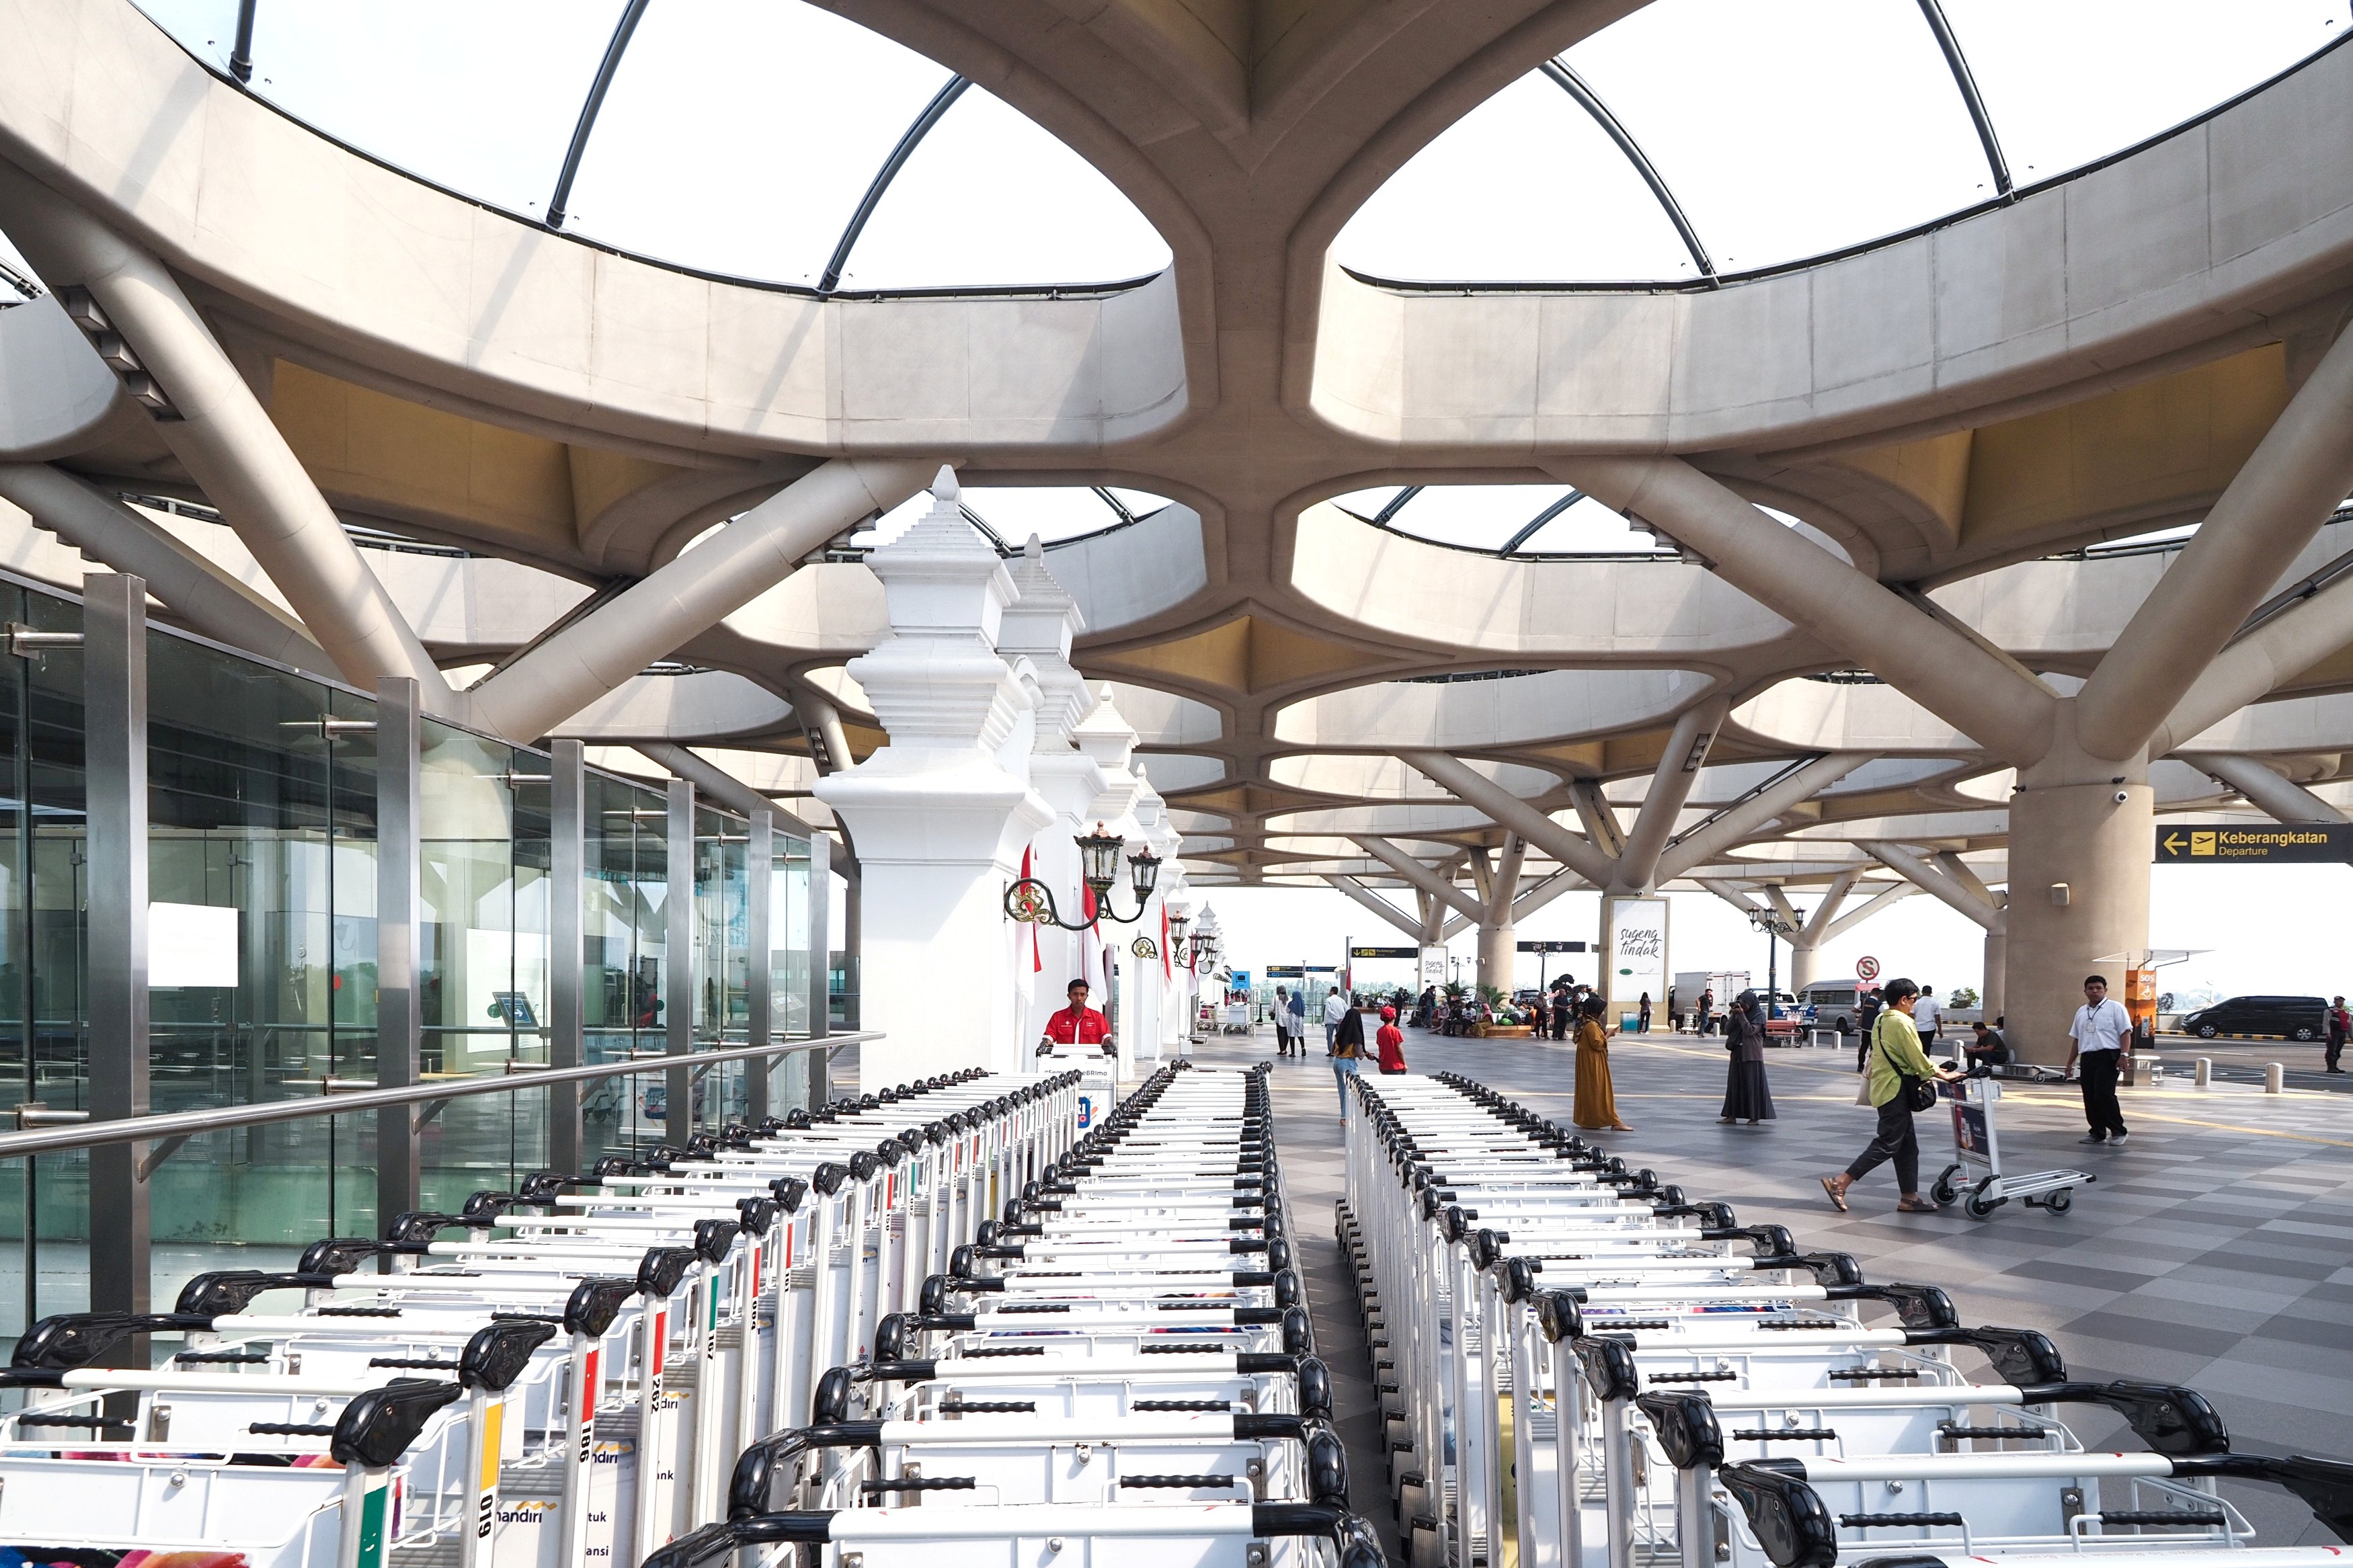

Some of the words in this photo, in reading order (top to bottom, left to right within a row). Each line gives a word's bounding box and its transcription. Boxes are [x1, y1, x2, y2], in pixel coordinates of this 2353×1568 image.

[2219, 831, 2327, 847] Keberangkatan
[2219, 846, 2268, 858] Departure
[1620, 928, 1662, 944] sugeng
[1620, 941, 1659, 958] tindak
[1076, 1103, 1086, 1114] RI
[651, 1378, 661, 1414] 262
[580, 1424, 592, 1463] 186
[478, 1493, 493, 1539] 019
[588, 1512, 607, 1522] tuk
[586, 1546, 609, 1557] ansi
